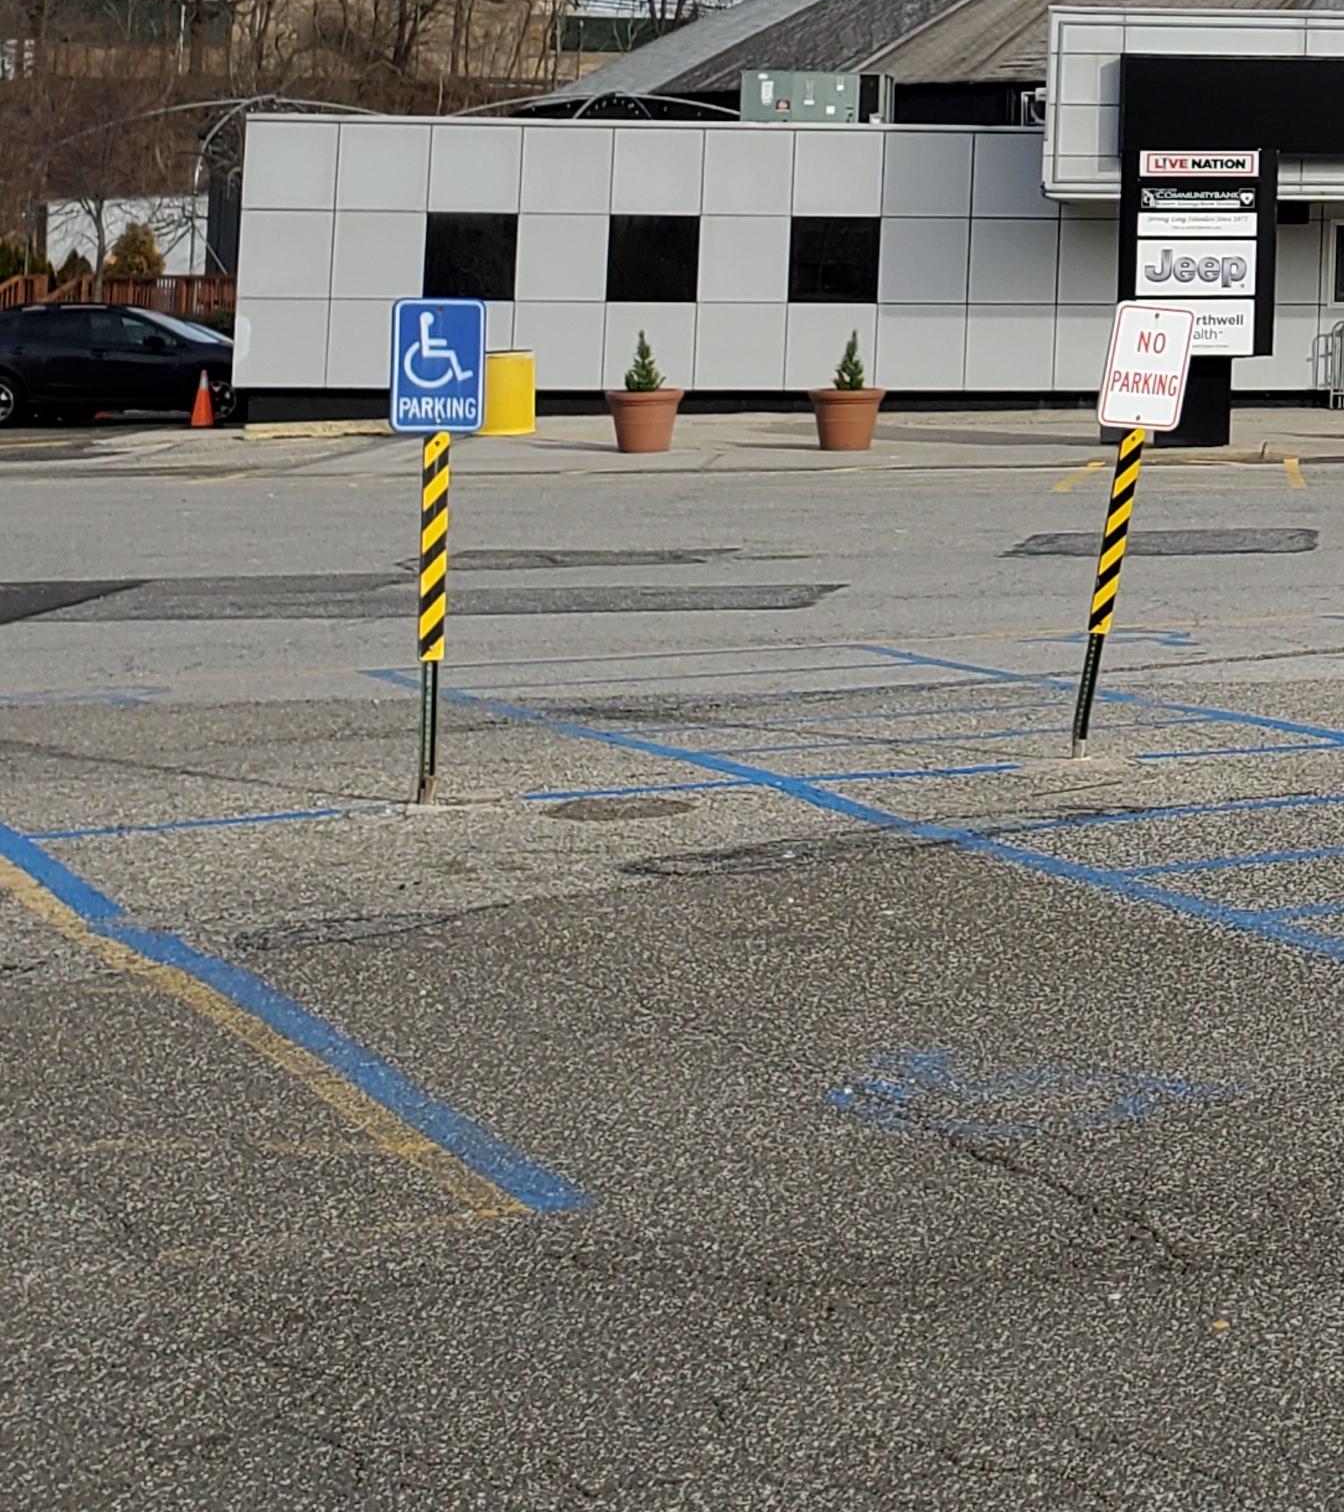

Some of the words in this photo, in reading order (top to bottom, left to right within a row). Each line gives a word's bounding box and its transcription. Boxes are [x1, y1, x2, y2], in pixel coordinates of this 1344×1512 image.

[1155, 158, 1188, 170] LIVE
[1191, 159, 1246, 169] NATION
[1144, 249, 1248, 288] Jeep
[1196, 314, 1244, 325] rthwell
[1136, 331, 1167, 354] NO
[1192, 328, 1219, 340] alth
[1110, 370, 1179, 397] PARKING
[400, 397, 476, 420] PARKING
